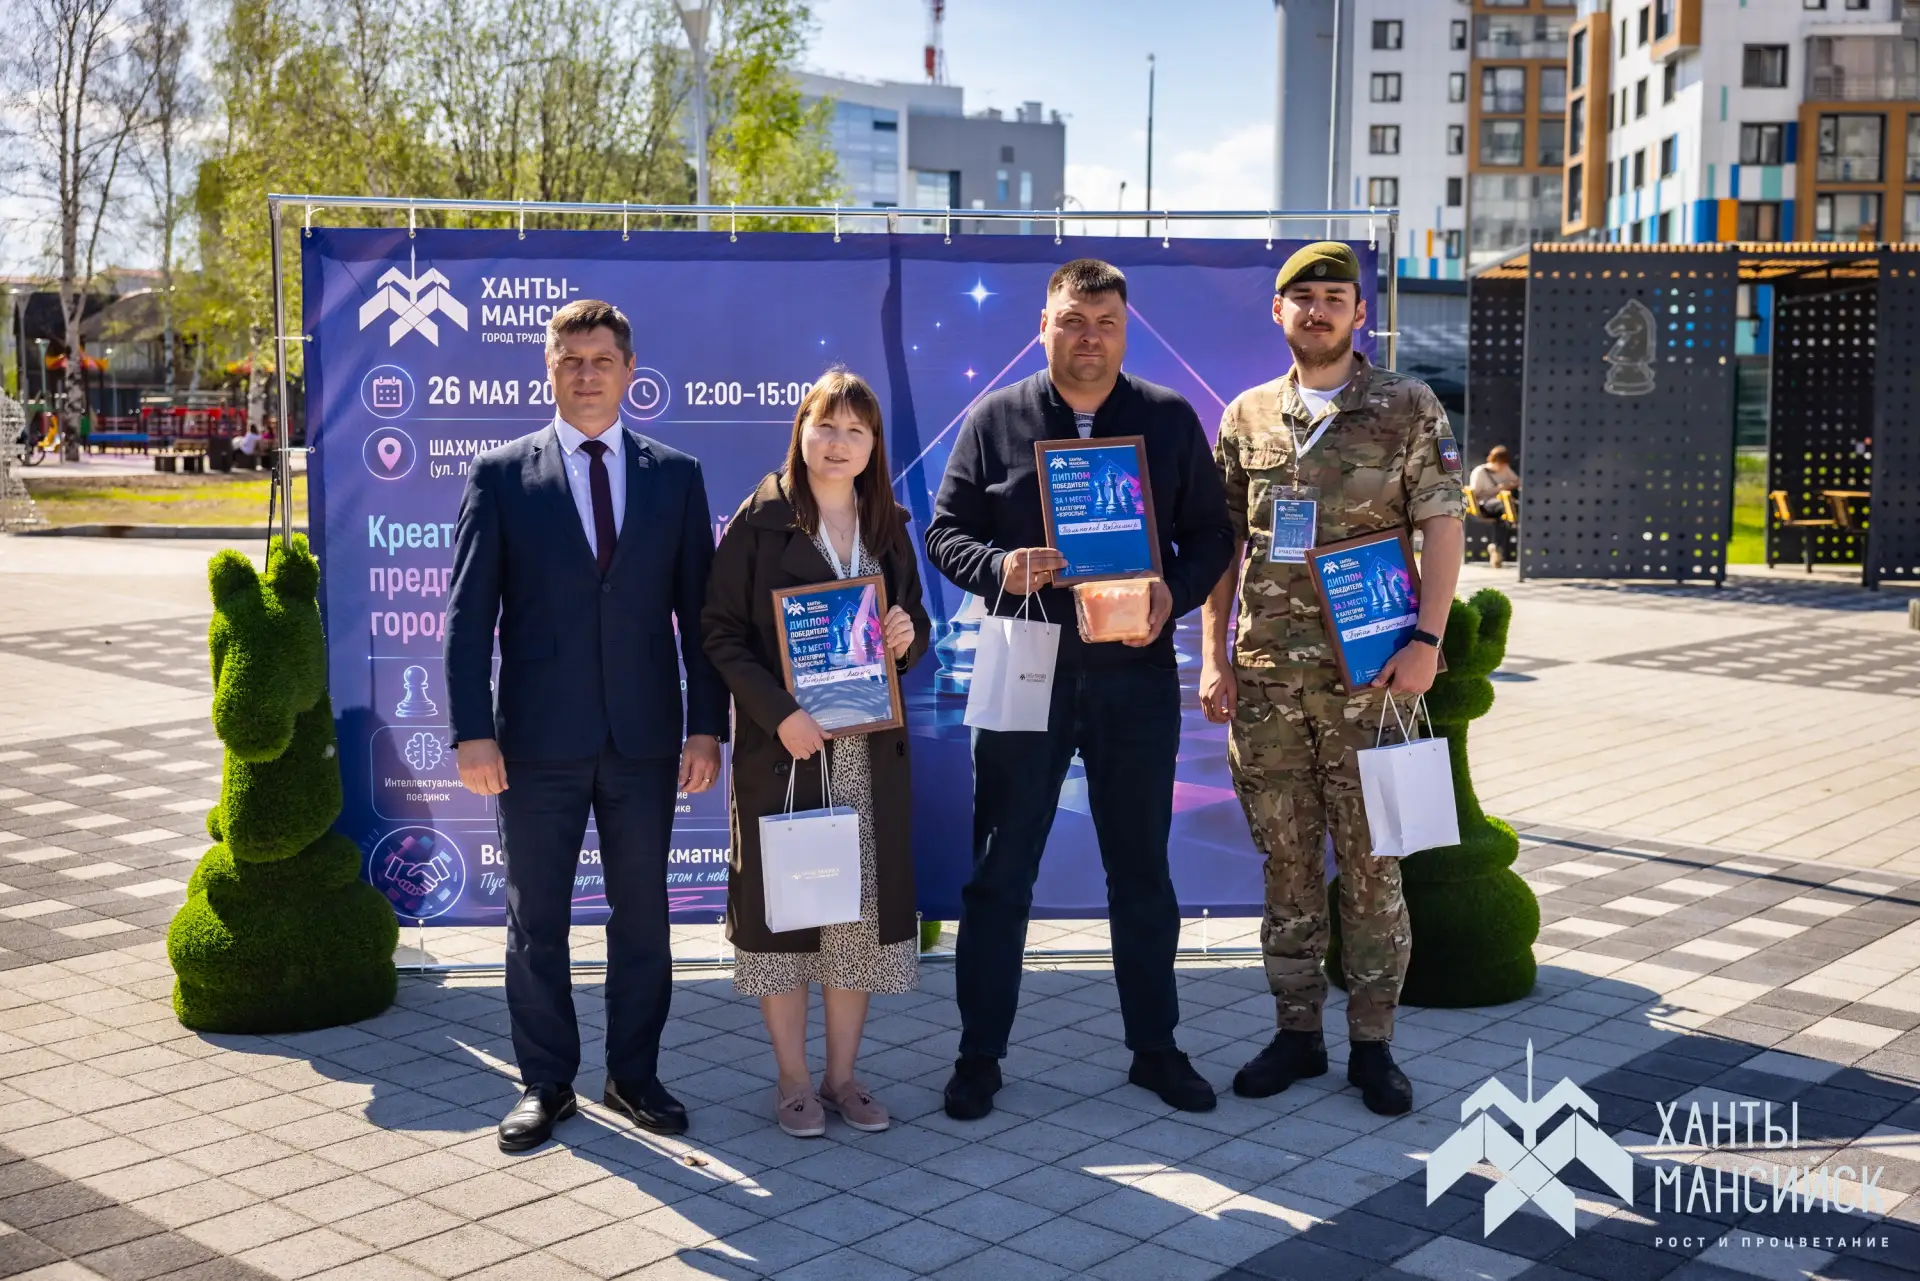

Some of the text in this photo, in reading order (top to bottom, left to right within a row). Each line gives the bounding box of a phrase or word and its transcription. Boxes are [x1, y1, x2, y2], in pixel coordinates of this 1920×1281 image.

[481, 277, 579, 299] ХАНТЫ-
[482, 333, 547, 345] ГОРОД ТРУДО
[428, 376, 556, 405] 26 МАЯ 20
[430, 461, 454, 478] (ул.
[1052, 471, 1091, 482] ДИПЛОМ
[1052, 481, 1089, 490] ПОБЕДИТЕЛЯ
[1069, 495, 1092, 504] МЕСТО
[368, 515, 459, 556] Креат
[1327, 572, 1363, 589] ДИПЛОМ
[1329, 582, 1363, 595] ПОБЕДИТЕЛЯ
[1333, 603, 1342, 611] ЗА
[1347, 596, 1368, 607] МЕСТО
[1340, 607, 1364, 617] КАТЕГОРИИ
[790, 616, 829, 631] ДИПЛОМ
[790, 627, 829, 638] ПОБЕДИТЕЛЯ
[793, 646, 802, 654] ЗА
[808, 642, 831, 652] МЕСТО
[798, 652, 826, 661] КАТЕГОРИИ
[406, 793, 451, 803] поединок
[668, 848, 731, 864] хматно
[480, 872, 506, 895] Пус
